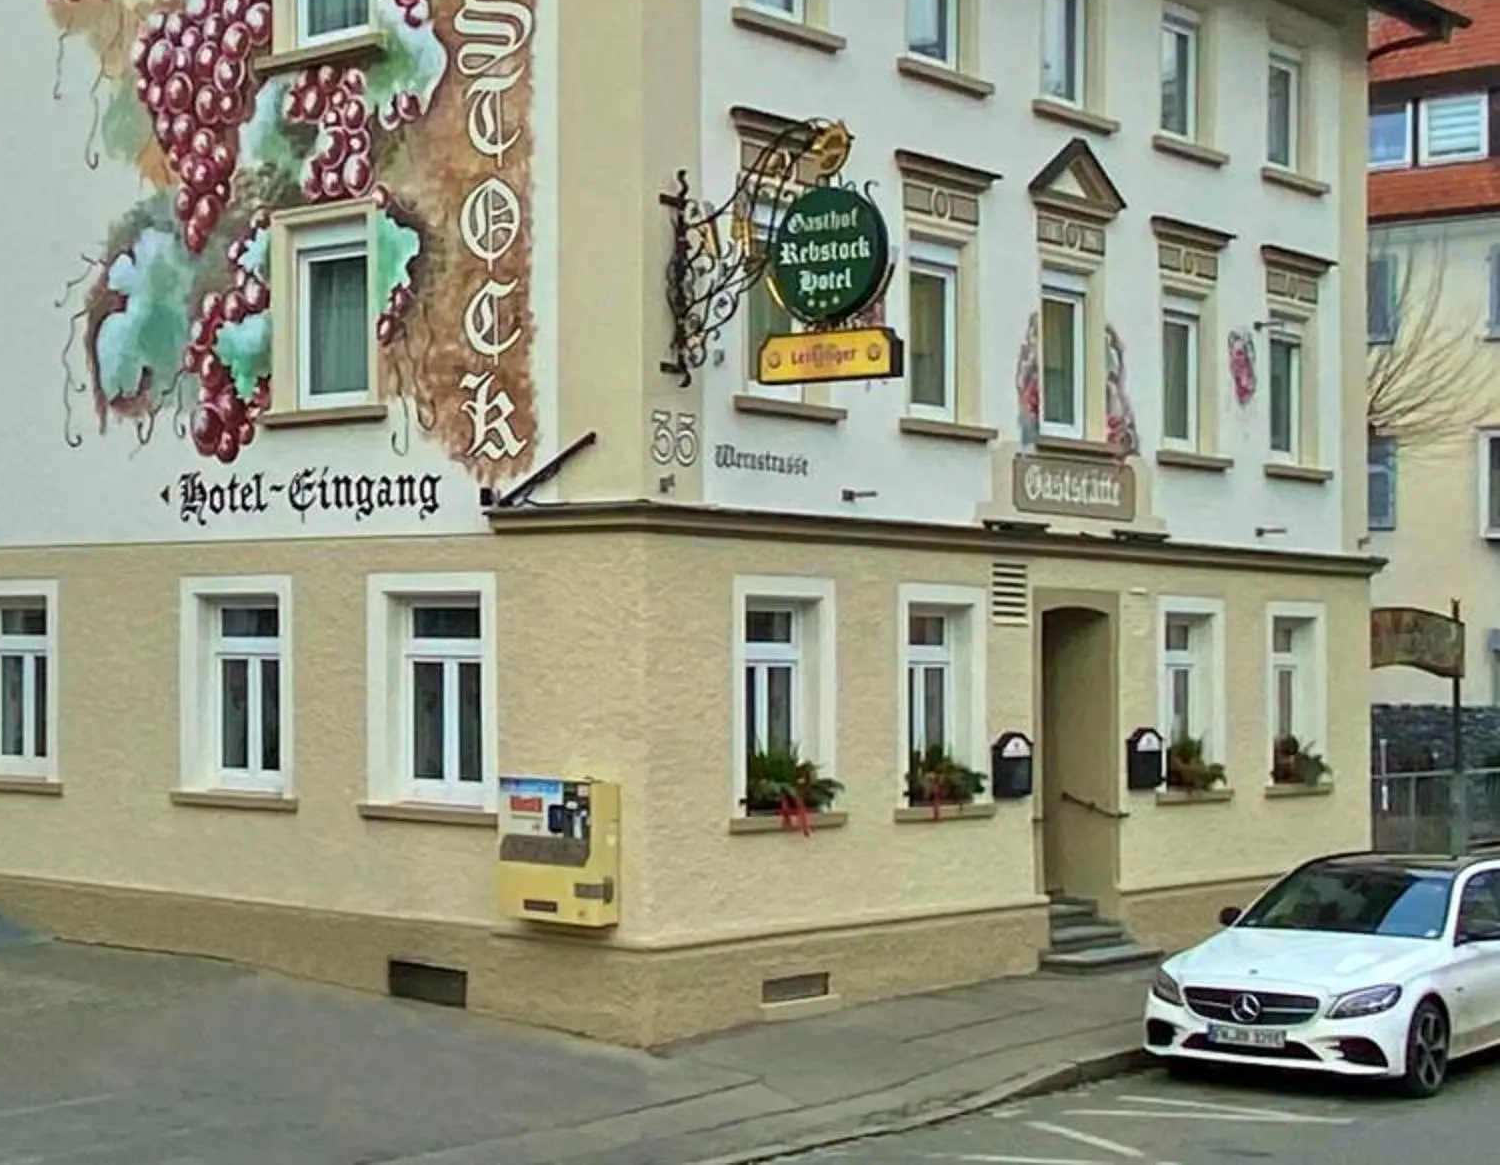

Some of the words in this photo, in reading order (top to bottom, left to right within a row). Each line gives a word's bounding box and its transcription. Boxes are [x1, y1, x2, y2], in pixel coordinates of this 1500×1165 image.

[787, 207, 859, 234] Gasthof
[779, 235, 871, 265] Rebstock
[799, 267, 852, 294] Hotel
[179, 467, 442, 525] Hotel-Eingang
